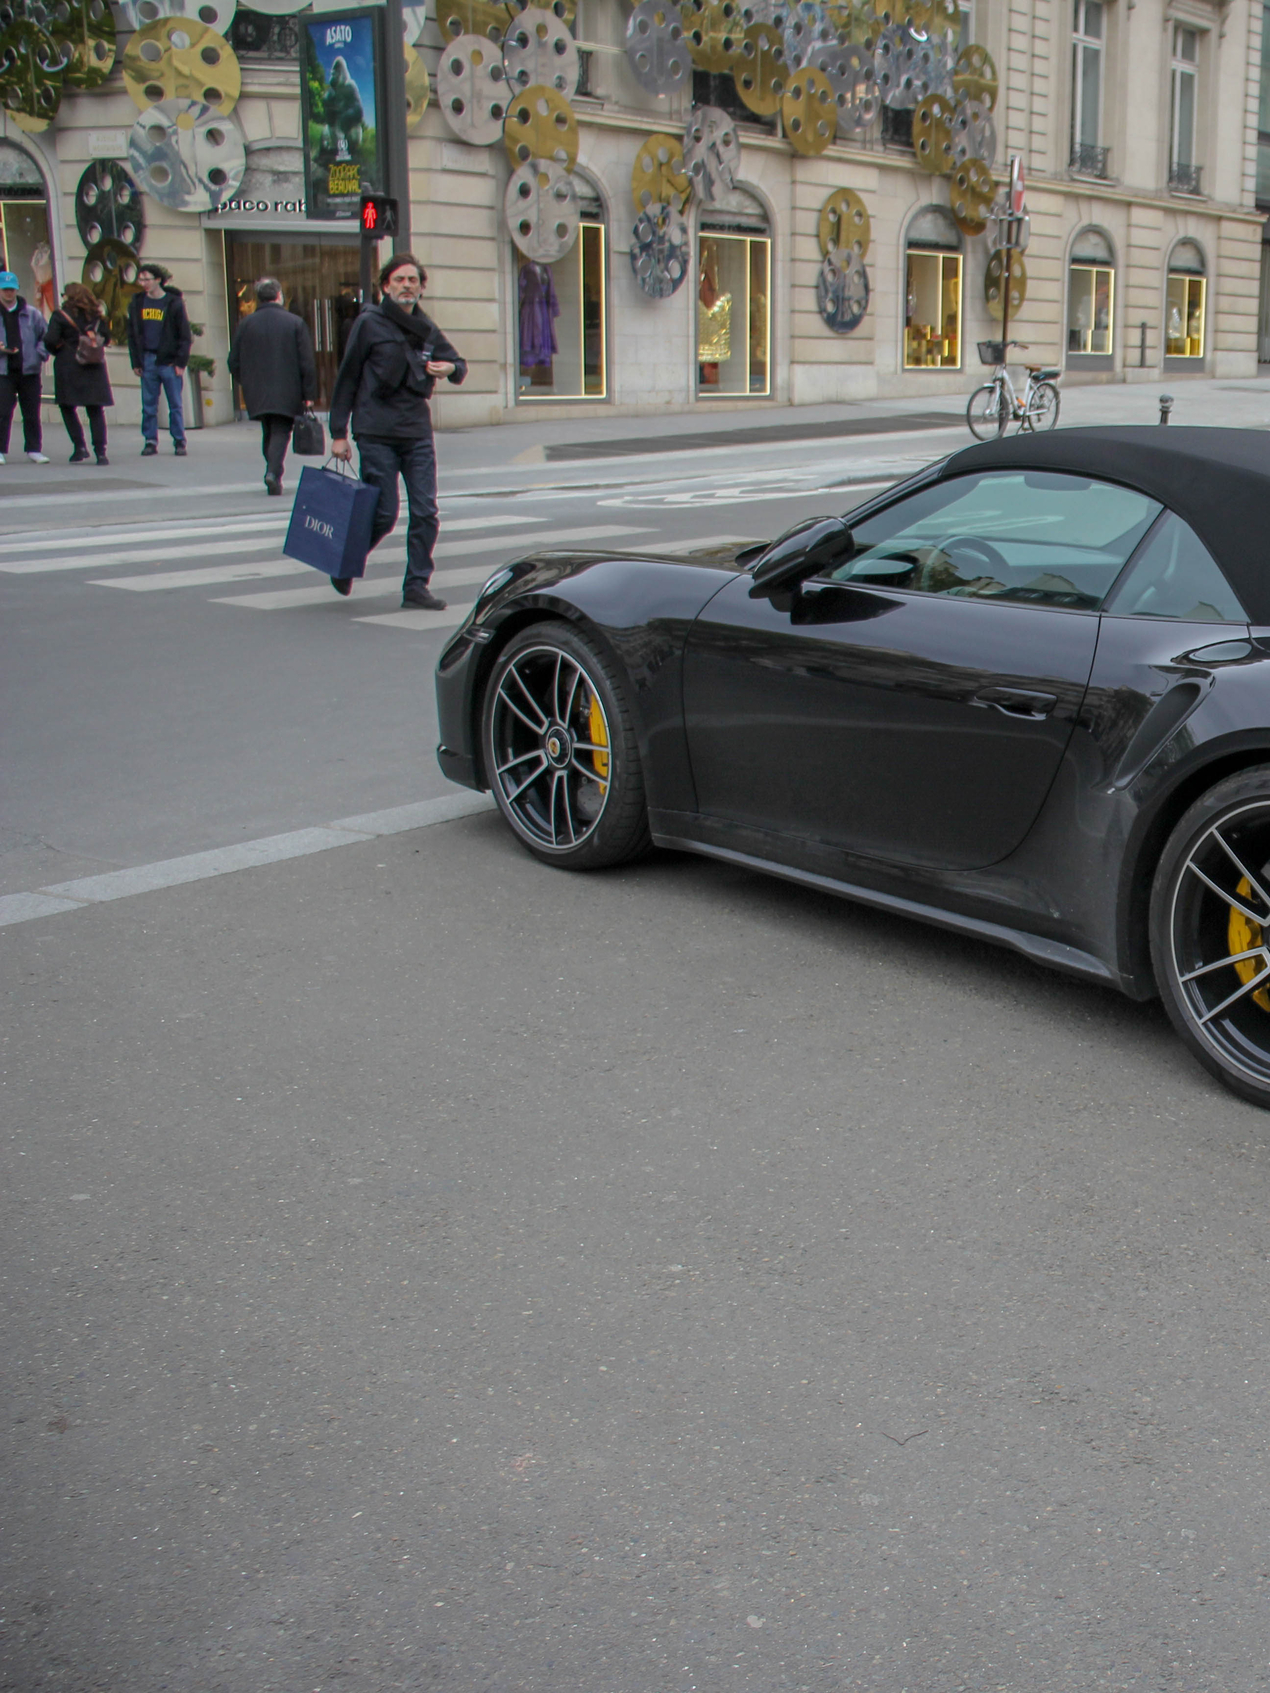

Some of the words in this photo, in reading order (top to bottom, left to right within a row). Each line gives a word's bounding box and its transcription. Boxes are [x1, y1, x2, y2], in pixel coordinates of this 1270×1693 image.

[326, 25, 353, 47] ASATO
[329, 178, 362, 195] BEAUVAL
[215, 199, 271, 214] paco
[304, 515, 335, 539] DIOR
